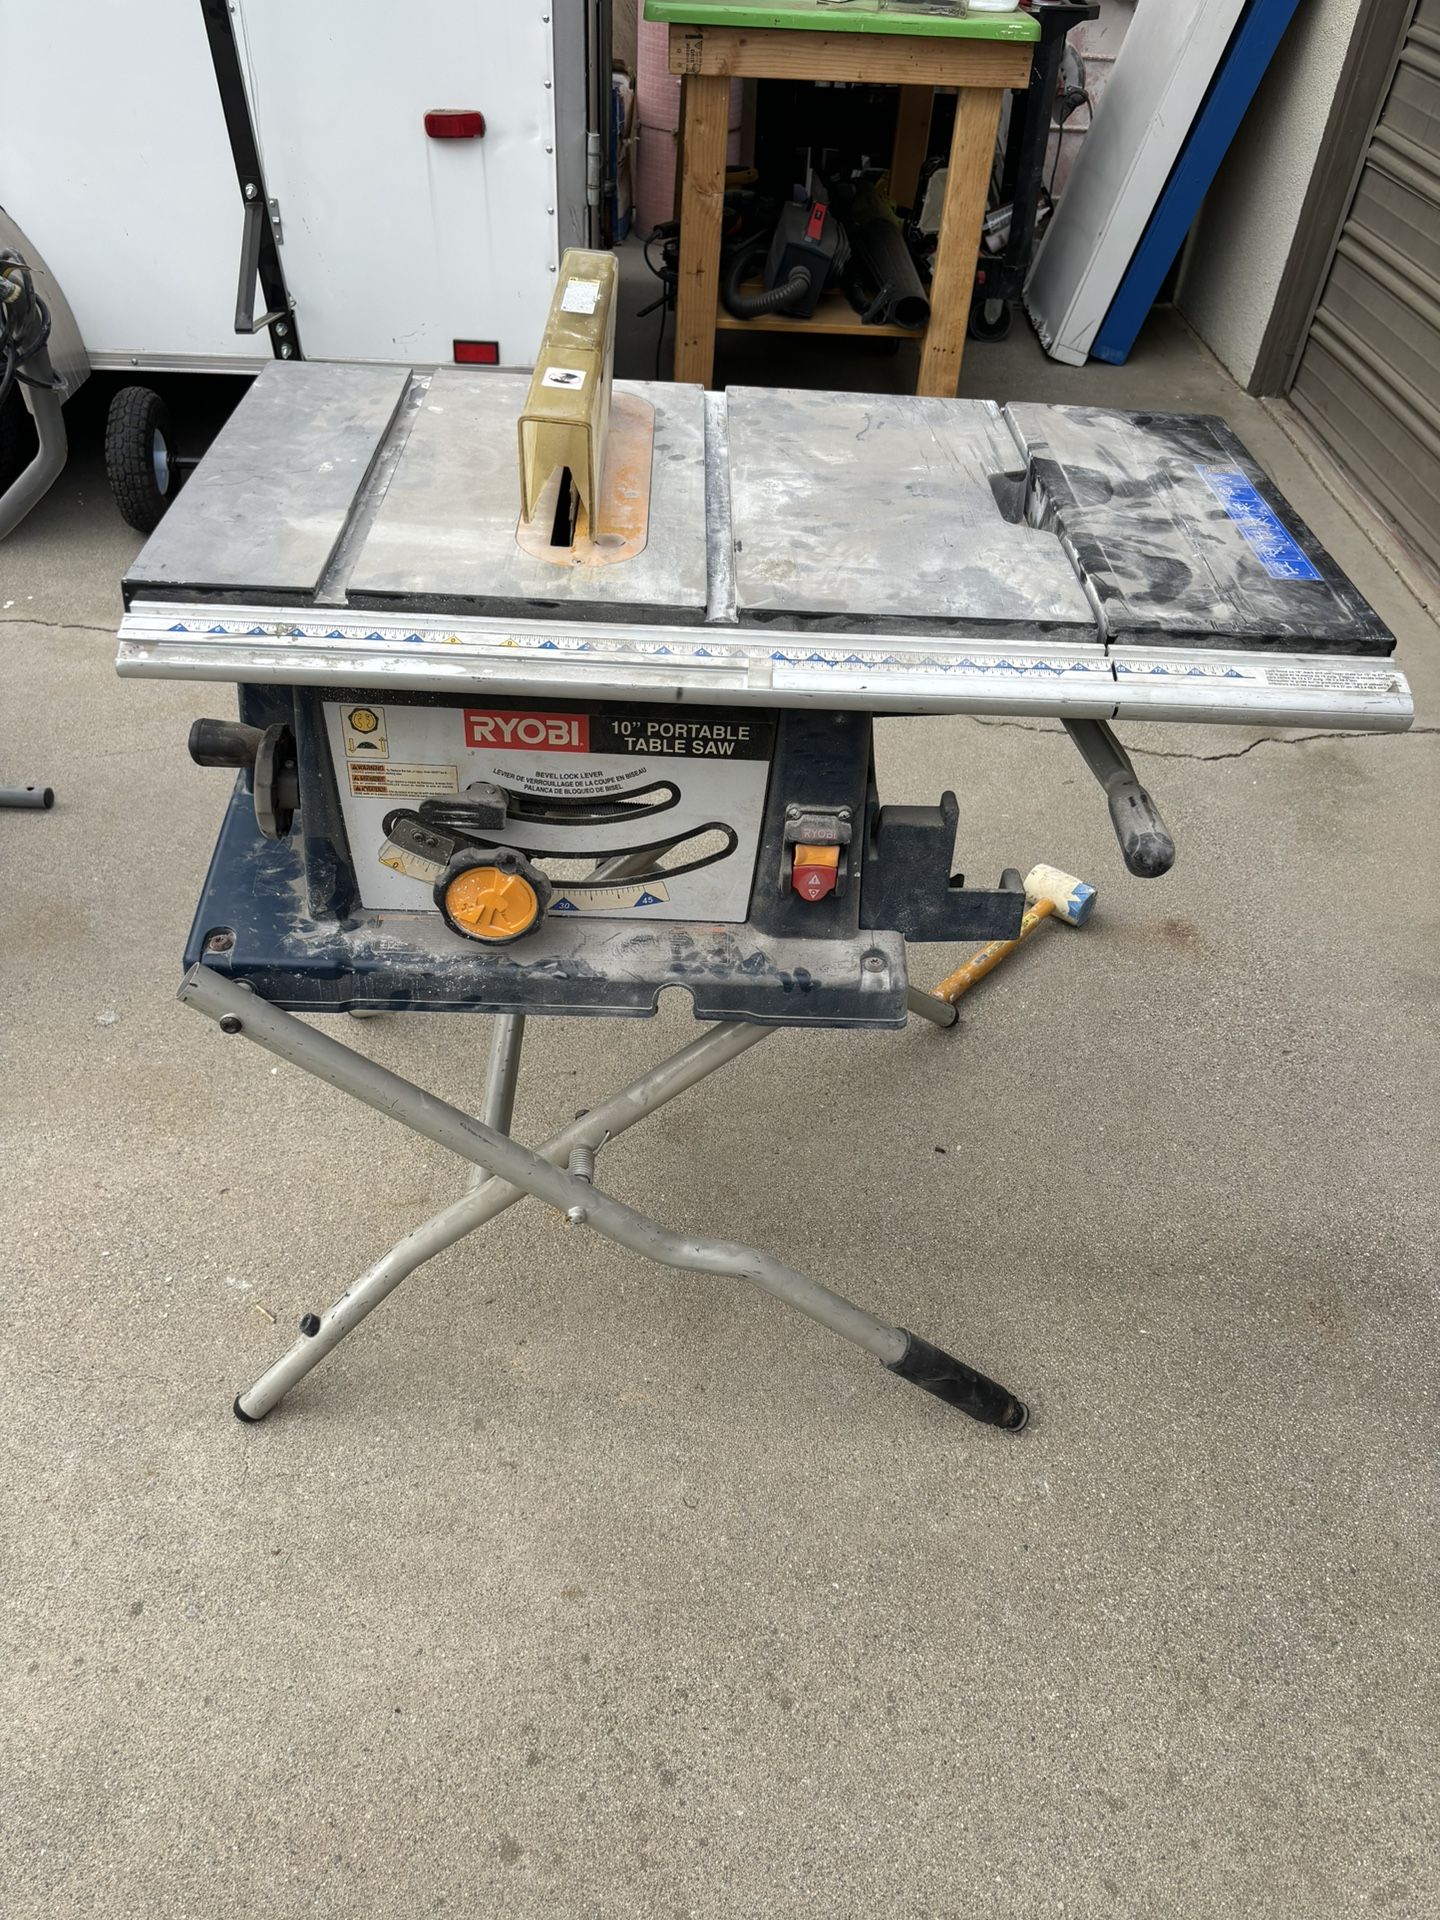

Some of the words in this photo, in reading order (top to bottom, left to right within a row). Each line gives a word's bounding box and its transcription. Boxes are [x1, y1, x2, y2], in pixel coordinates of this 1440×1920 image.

[470, 715, 580, 747] RYOBI
[647, 722, 751, 741] PORTABLE
[624, 737, 687, 754] TABLE
[691, 740, 736, 756] SAW
[493, 768, 516, 780] LEVIER
[516, 775, 525, 783] DE
[526, 777, 574, 788] VERROUILLAGE
[594, 777, 616, 786] COUPE
[625, 767, 647, 780] BISEAU
[535, 771, 559, 780] BEVEL
[580, 770, 604, 779] LEVER
[523, 783, 553, 794] PALANCA
[564, 787, 595, 795] BLOQUEO
[605, 783, 623, 792] BISEL
[803, 827, 837, 840] RYOBI
[559, 902, 570, 910] 30
[642, 896, 654, 904] 45
